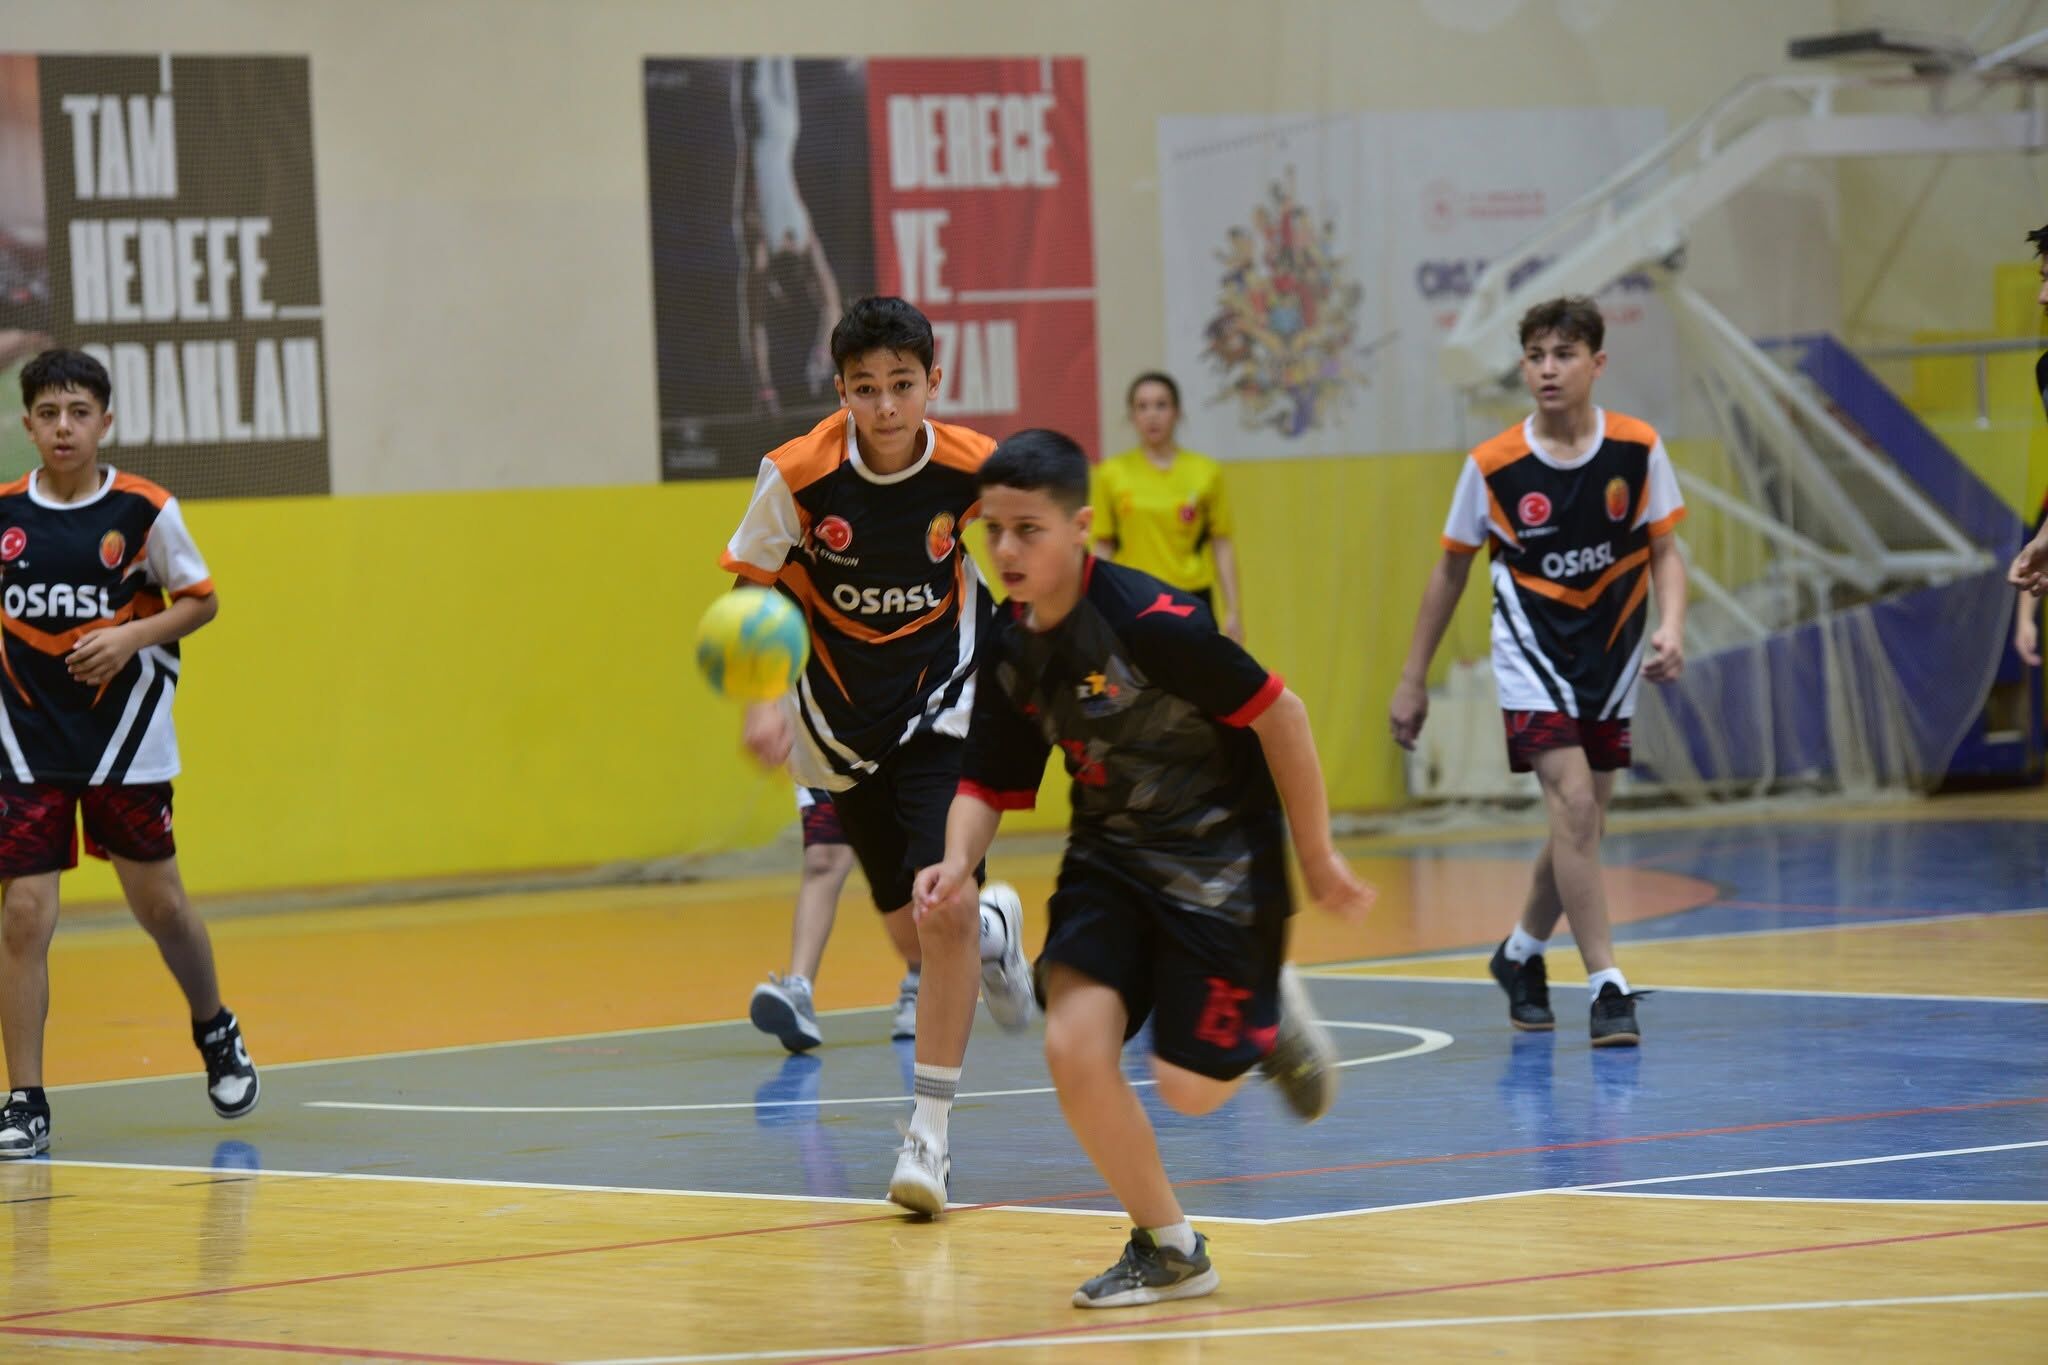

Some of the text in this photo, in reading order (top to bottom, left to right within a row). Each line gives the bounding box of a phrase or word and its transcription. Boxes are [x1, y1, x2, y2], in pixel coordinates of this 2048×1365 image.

[62, 94, 178, 199] TAM
[887, 94, 1060, 190] DERECE
[69, 217, 274, 324] HEDEFE
[927, 318, 1022, 417] ZAN
